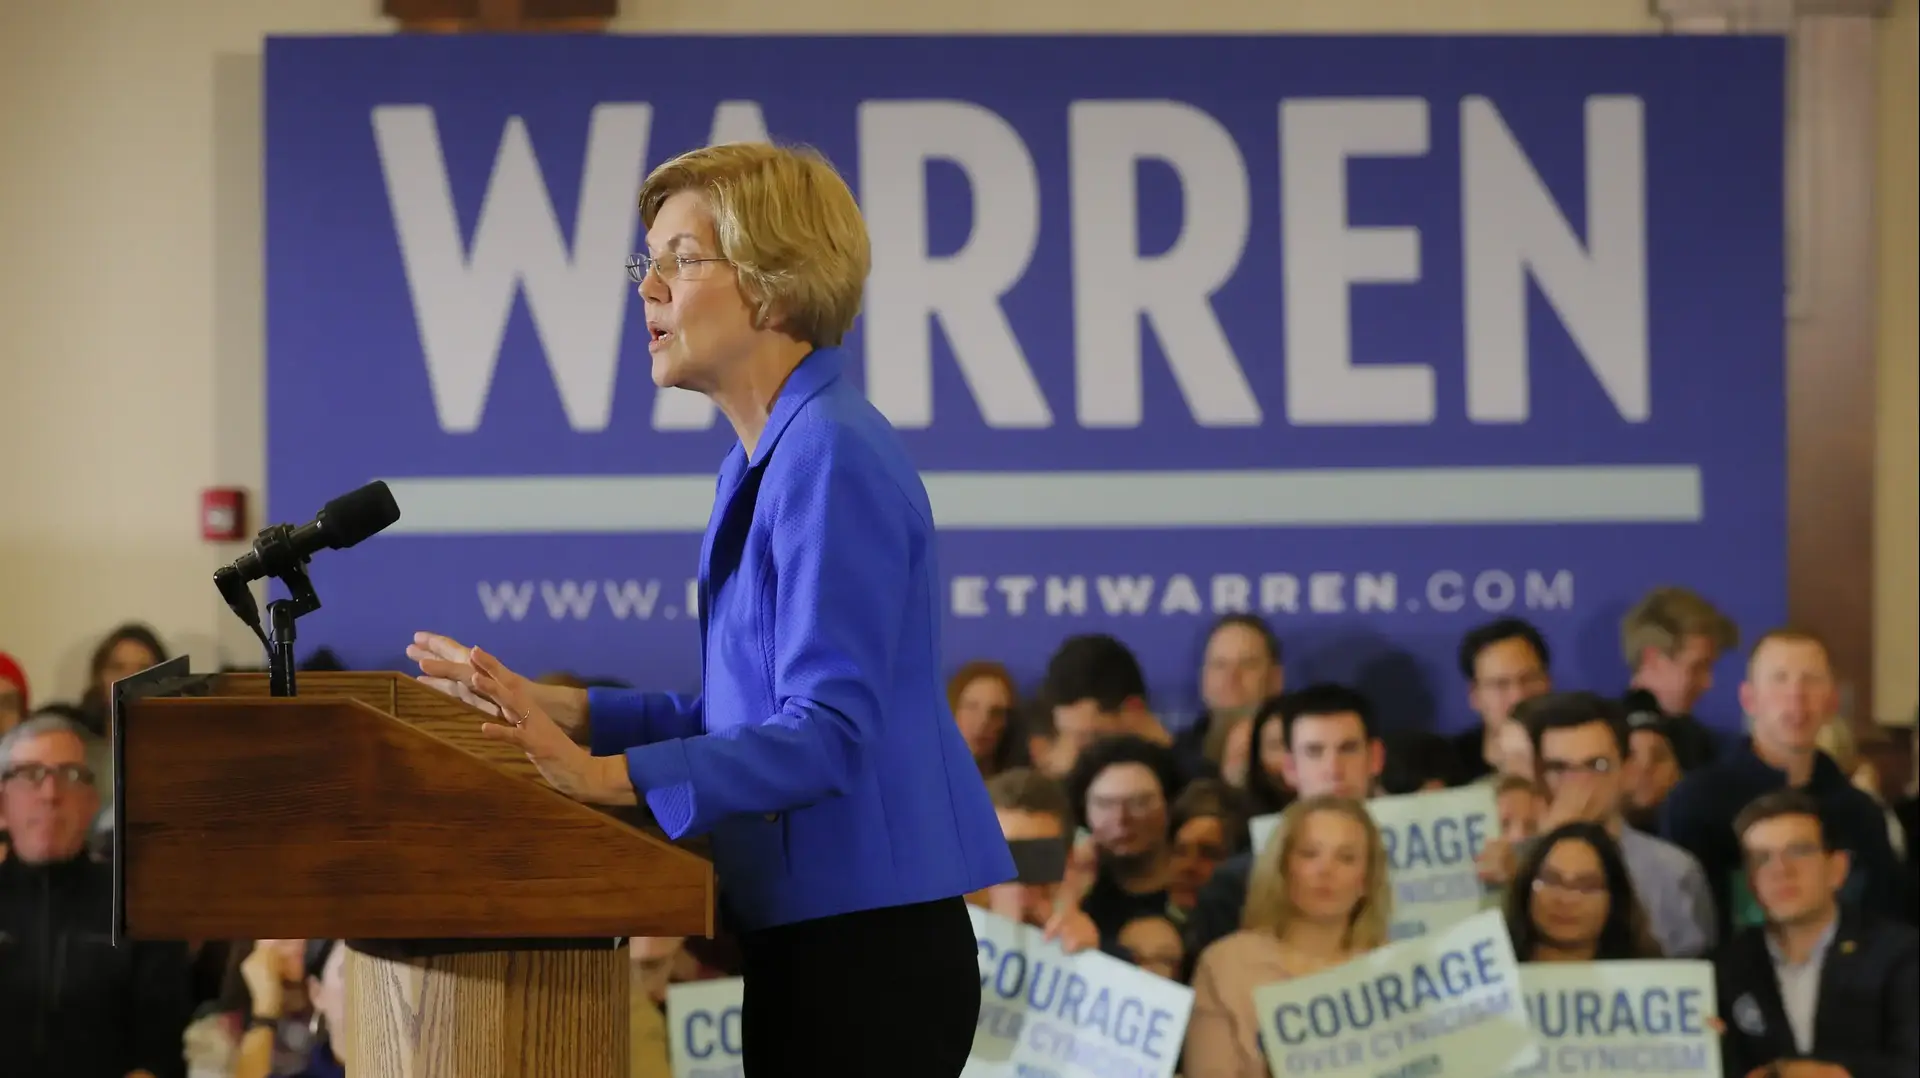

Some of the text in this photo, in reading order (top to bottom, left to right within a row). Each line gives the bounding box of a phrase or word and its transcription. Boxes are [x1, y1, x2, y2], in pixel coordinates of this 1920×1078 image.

[370, 94, 1651, 434] WRREN
[1274, 938, 1503, 1045] COURAGE
[1525, 984, 1703, 1039] URAGE
